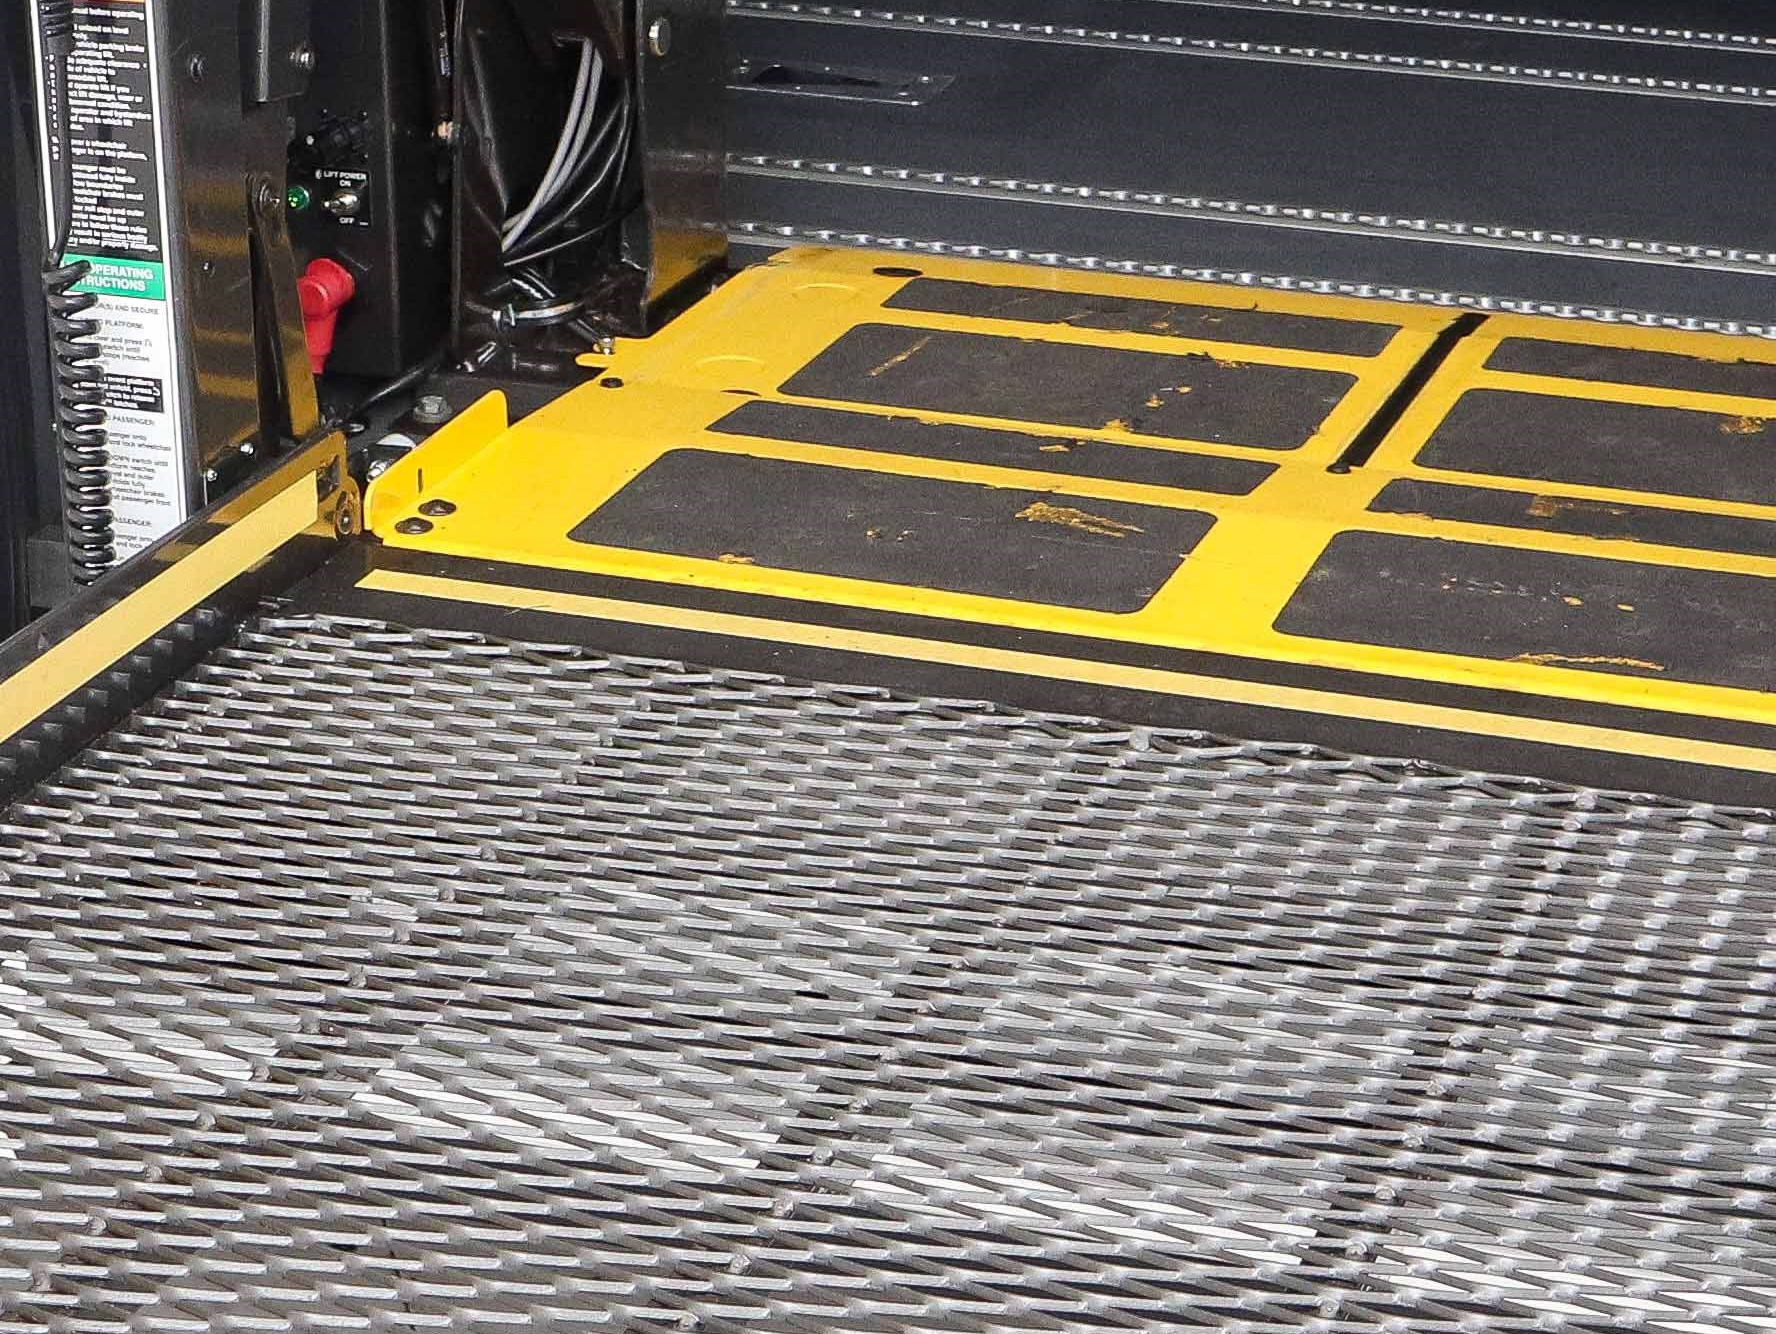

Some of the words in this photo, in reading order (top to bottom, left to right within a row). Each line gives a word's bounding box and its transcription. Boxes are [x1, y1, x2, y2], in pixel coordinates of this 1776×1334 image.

[323, 170, 339, 179] LIFT
[339, 171, 367, 181] POWER
[339, 179, 352, 187] ON
[339, 216, 355, 224] OFF
